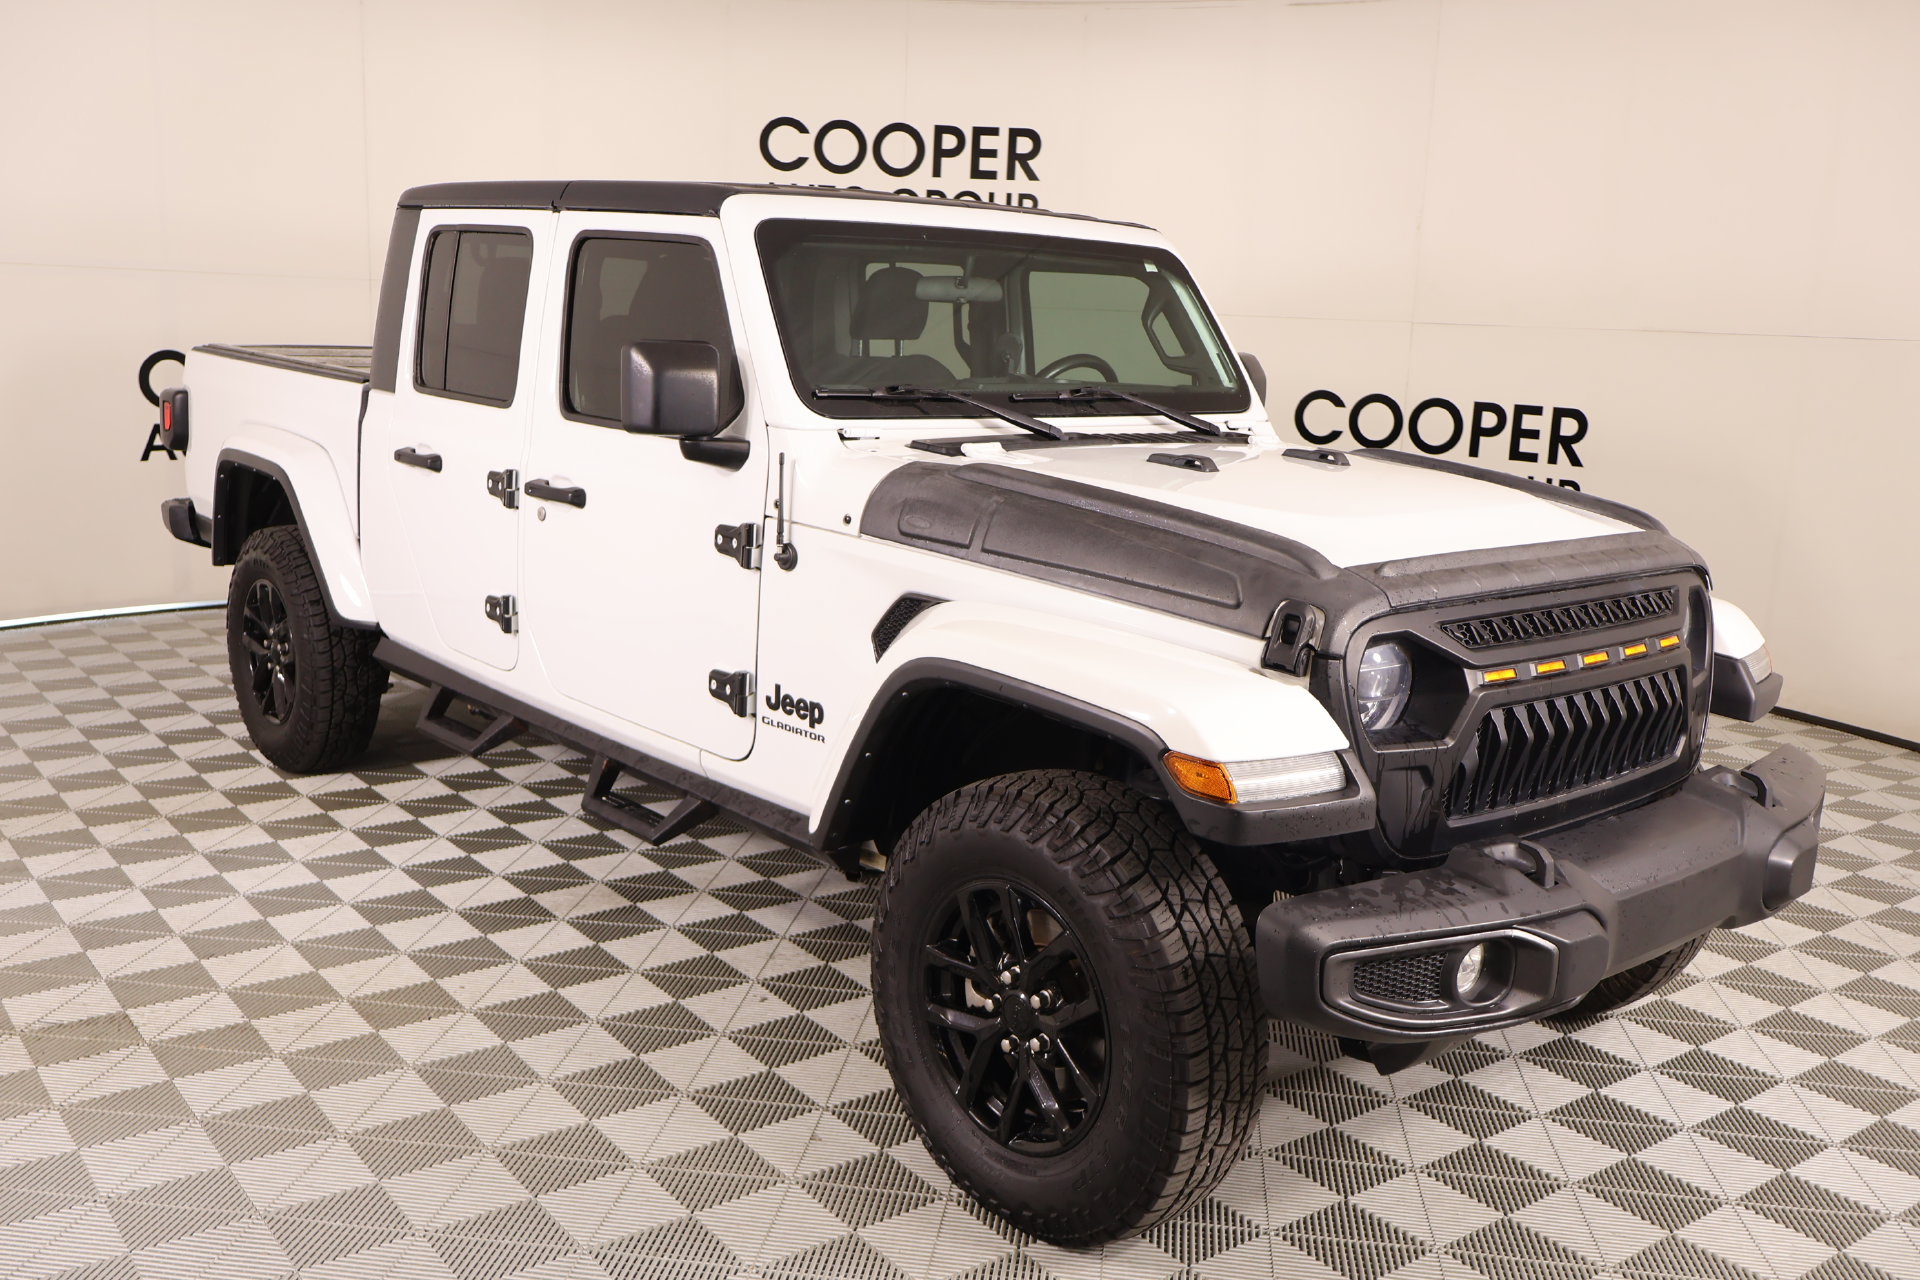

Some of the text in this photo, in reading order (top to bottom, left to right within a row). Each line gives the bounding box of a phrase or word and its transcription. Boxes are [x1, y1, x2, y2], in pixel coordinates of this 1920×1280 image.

[759, 116, 1042, 181] COOPER
[1294, 389, 1589, 468] COOPER
[761, 716, 826, 744] GLADIATOR
[765, 683, 824, 729] Jeep
